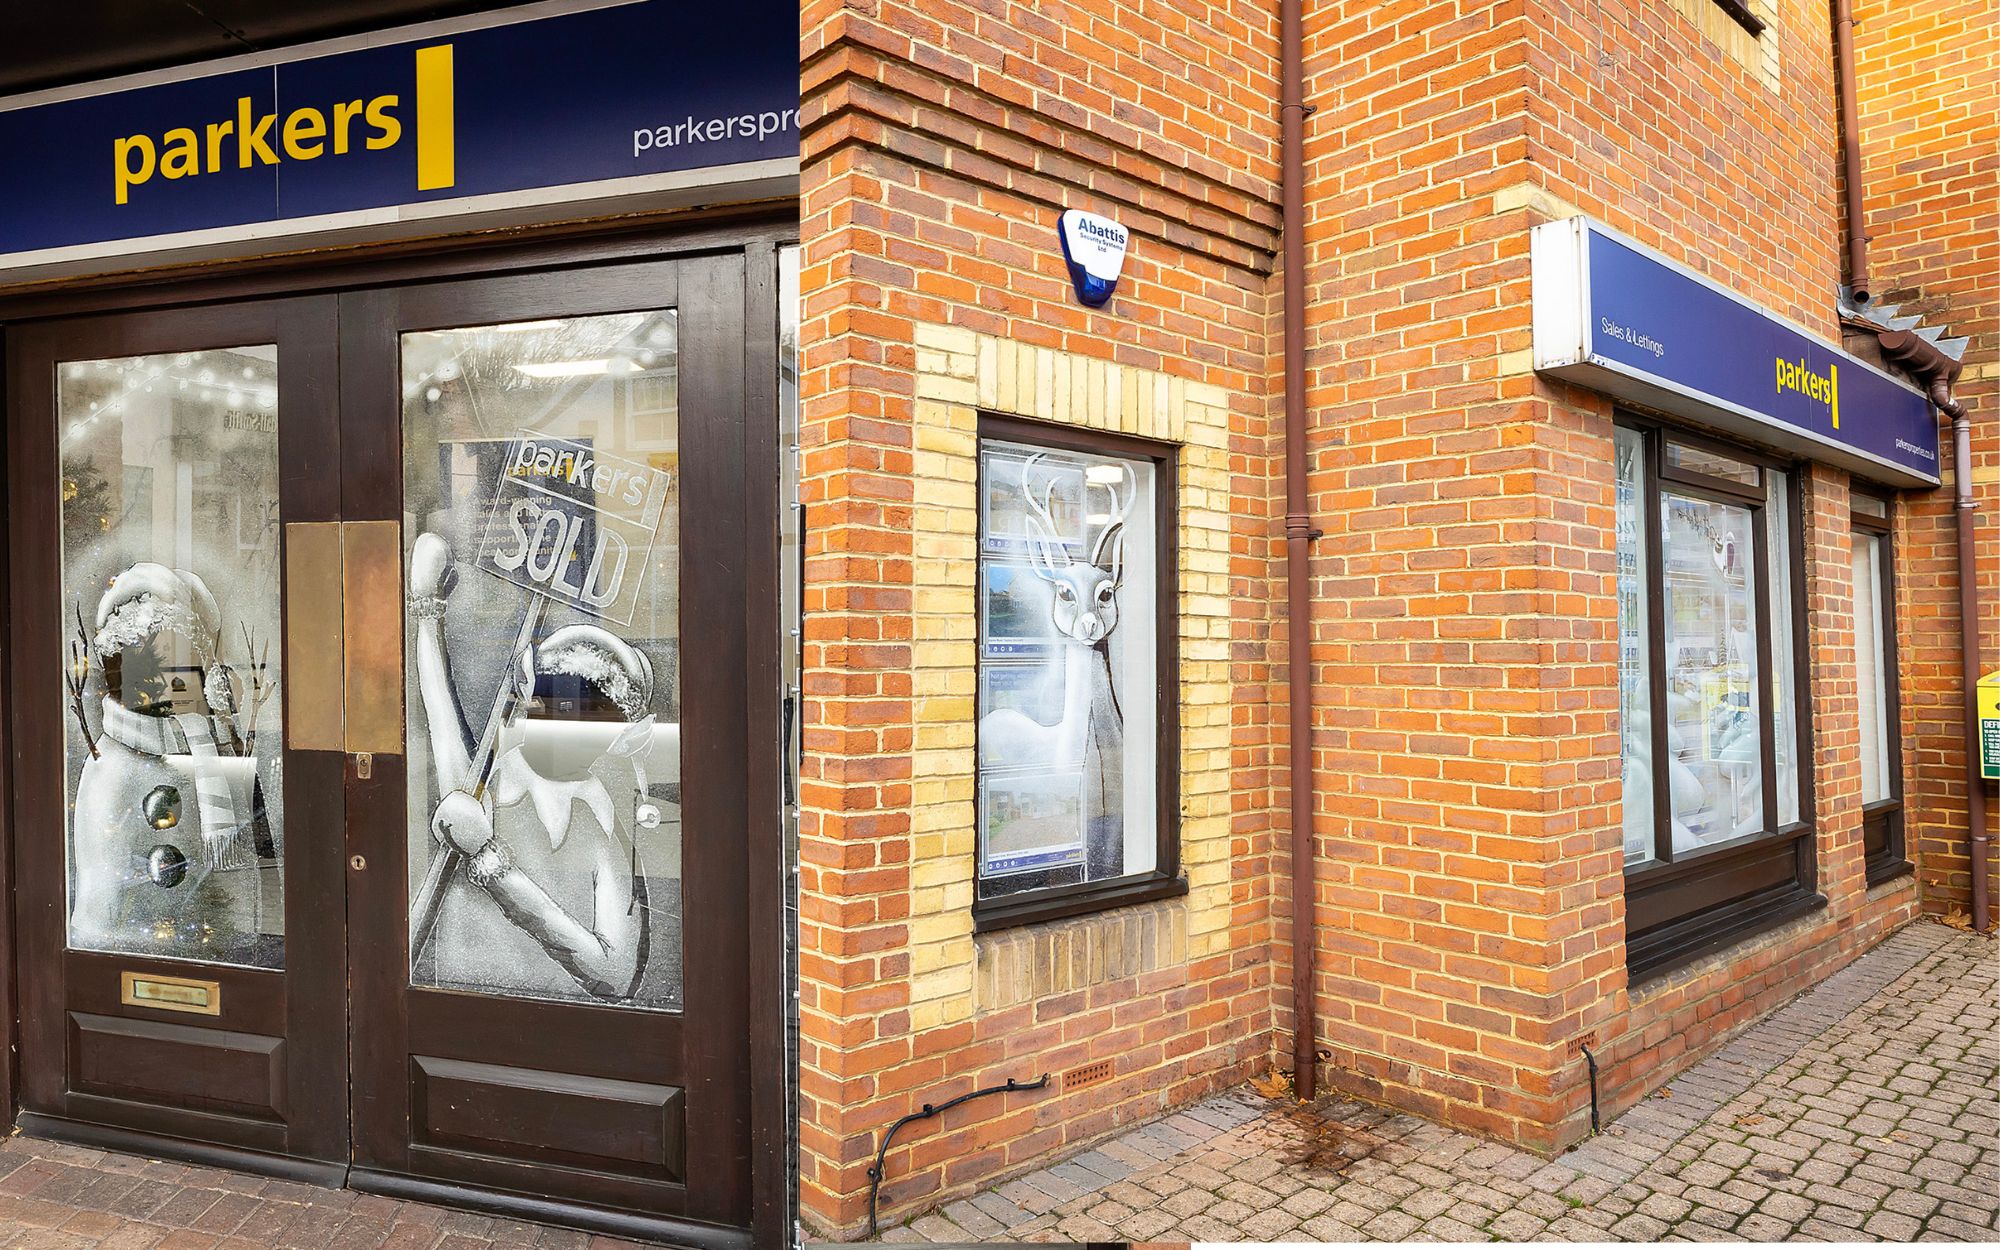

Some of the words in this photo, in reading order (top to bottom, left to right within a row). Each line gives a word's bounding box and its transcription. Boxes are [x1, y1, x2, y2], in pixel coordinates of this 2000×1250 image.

[115, 94, 402, 205] parkers
[1079, 218, 1125, 244] Abattis
[1080, 232, 1102, 245] Security
[1102, 239, 1124, 251] Systems
[1097, 245, 1107, 253] Ltd
[1602, 317, 1625, 340] Sales
[1626, 327, 1632, 343] &
[1632, 330, 1664, 358] Lettings
[1775, 357, 1831, 405] parkers
[513, 437, 648, 506] parkers
[493, 515, 629, 608] SOLD
